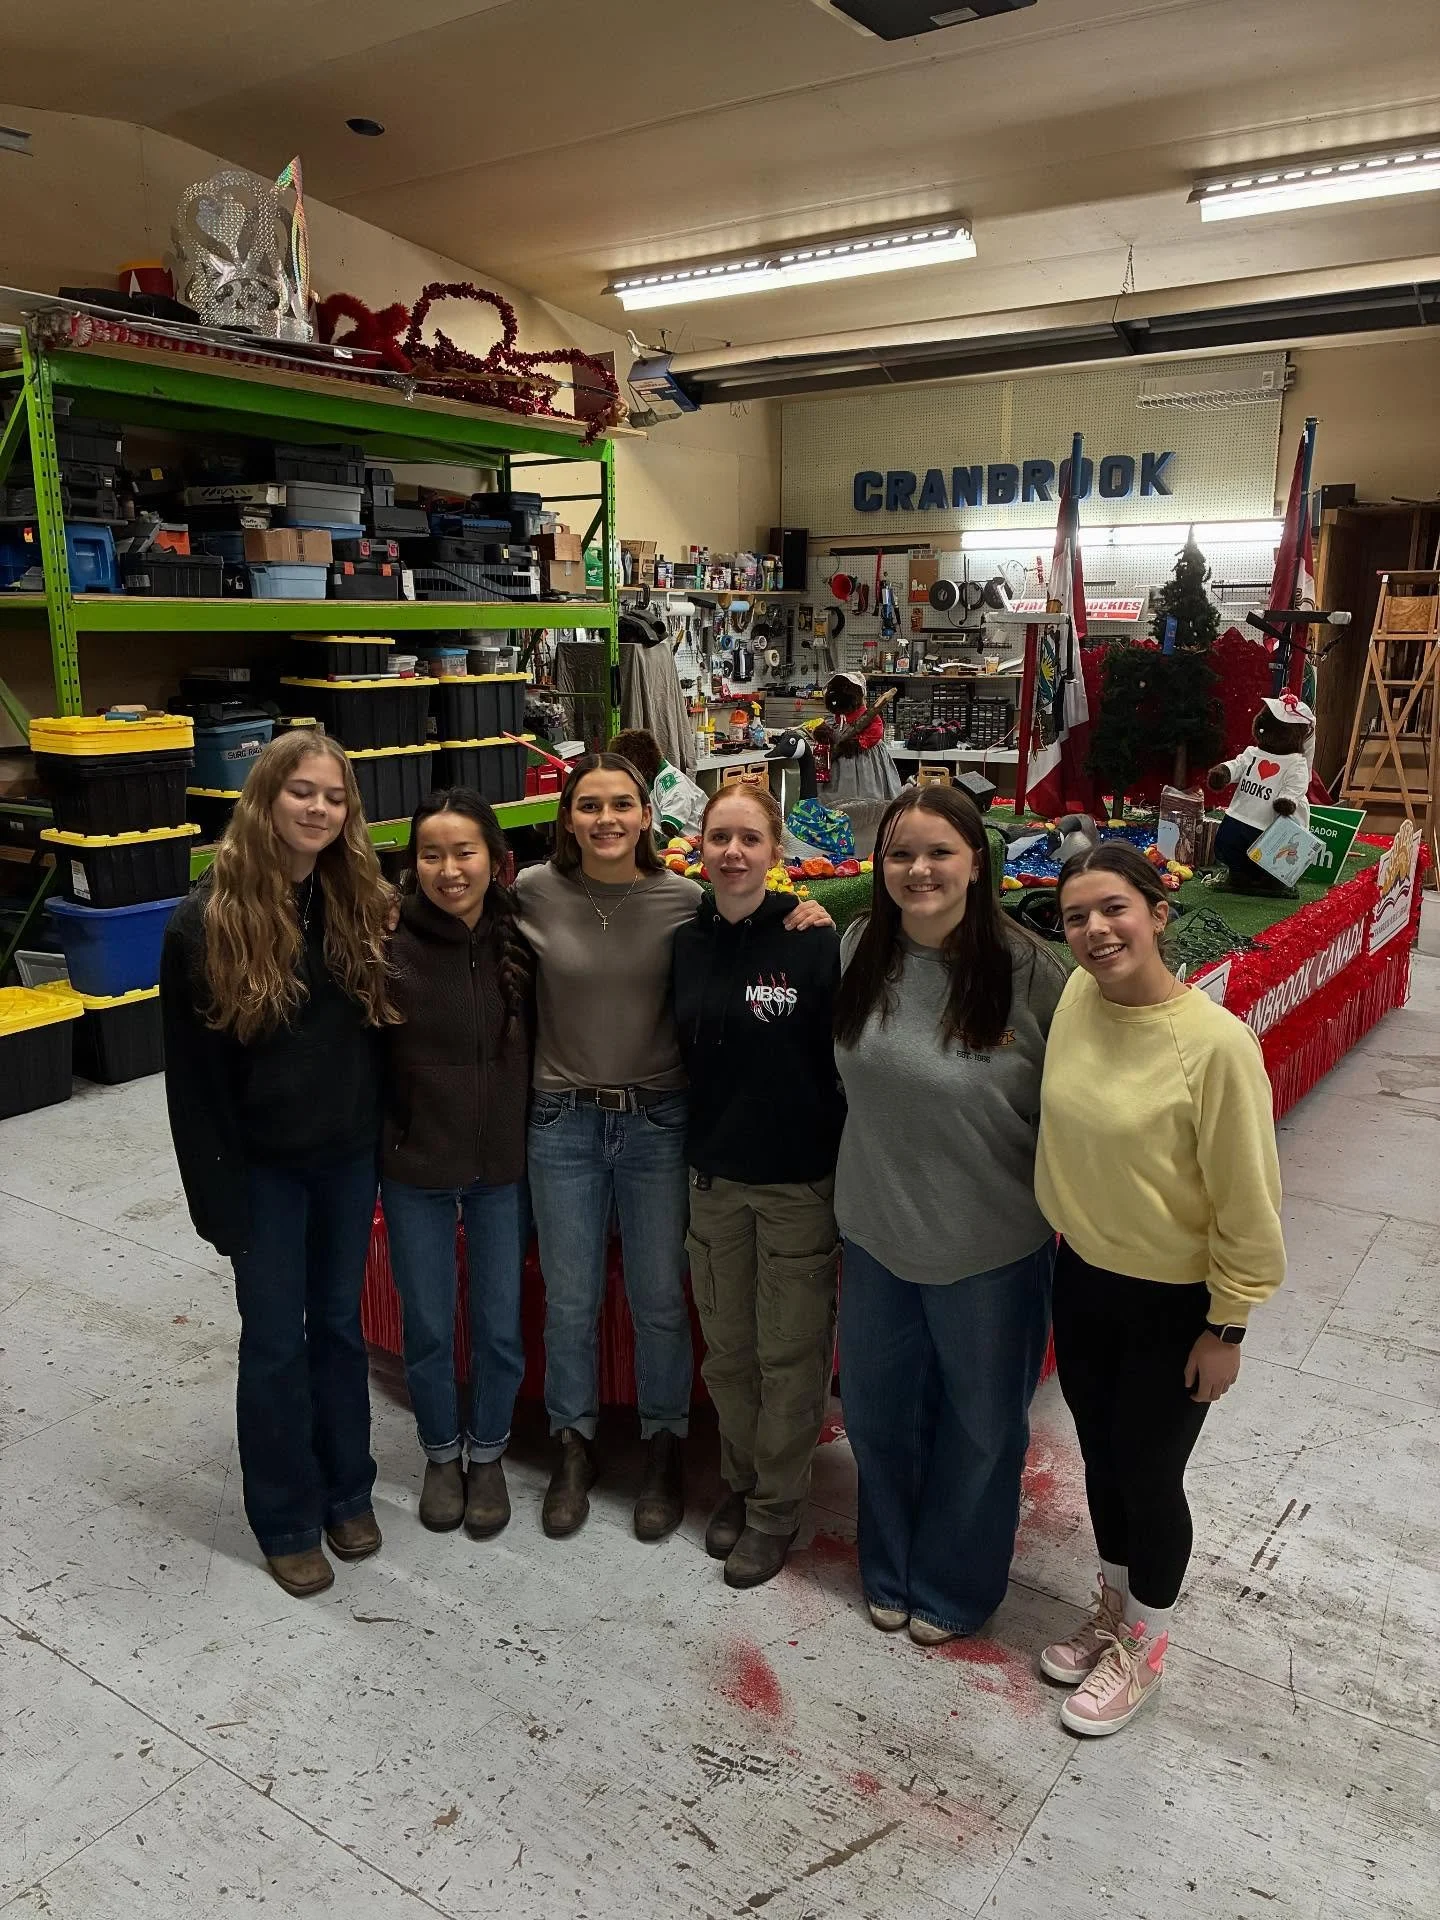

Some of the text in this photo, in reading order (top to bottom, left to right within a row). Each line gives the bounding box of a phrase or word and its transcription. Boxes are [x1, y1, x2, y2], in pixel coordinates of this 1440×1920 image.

[1245, 756, 1257, 777] I
[1240, 778, 1273, 801] BOOKS
[1316, 917, 1365, 987] CANADA
[745, 985, 798, 1004] MBSS
